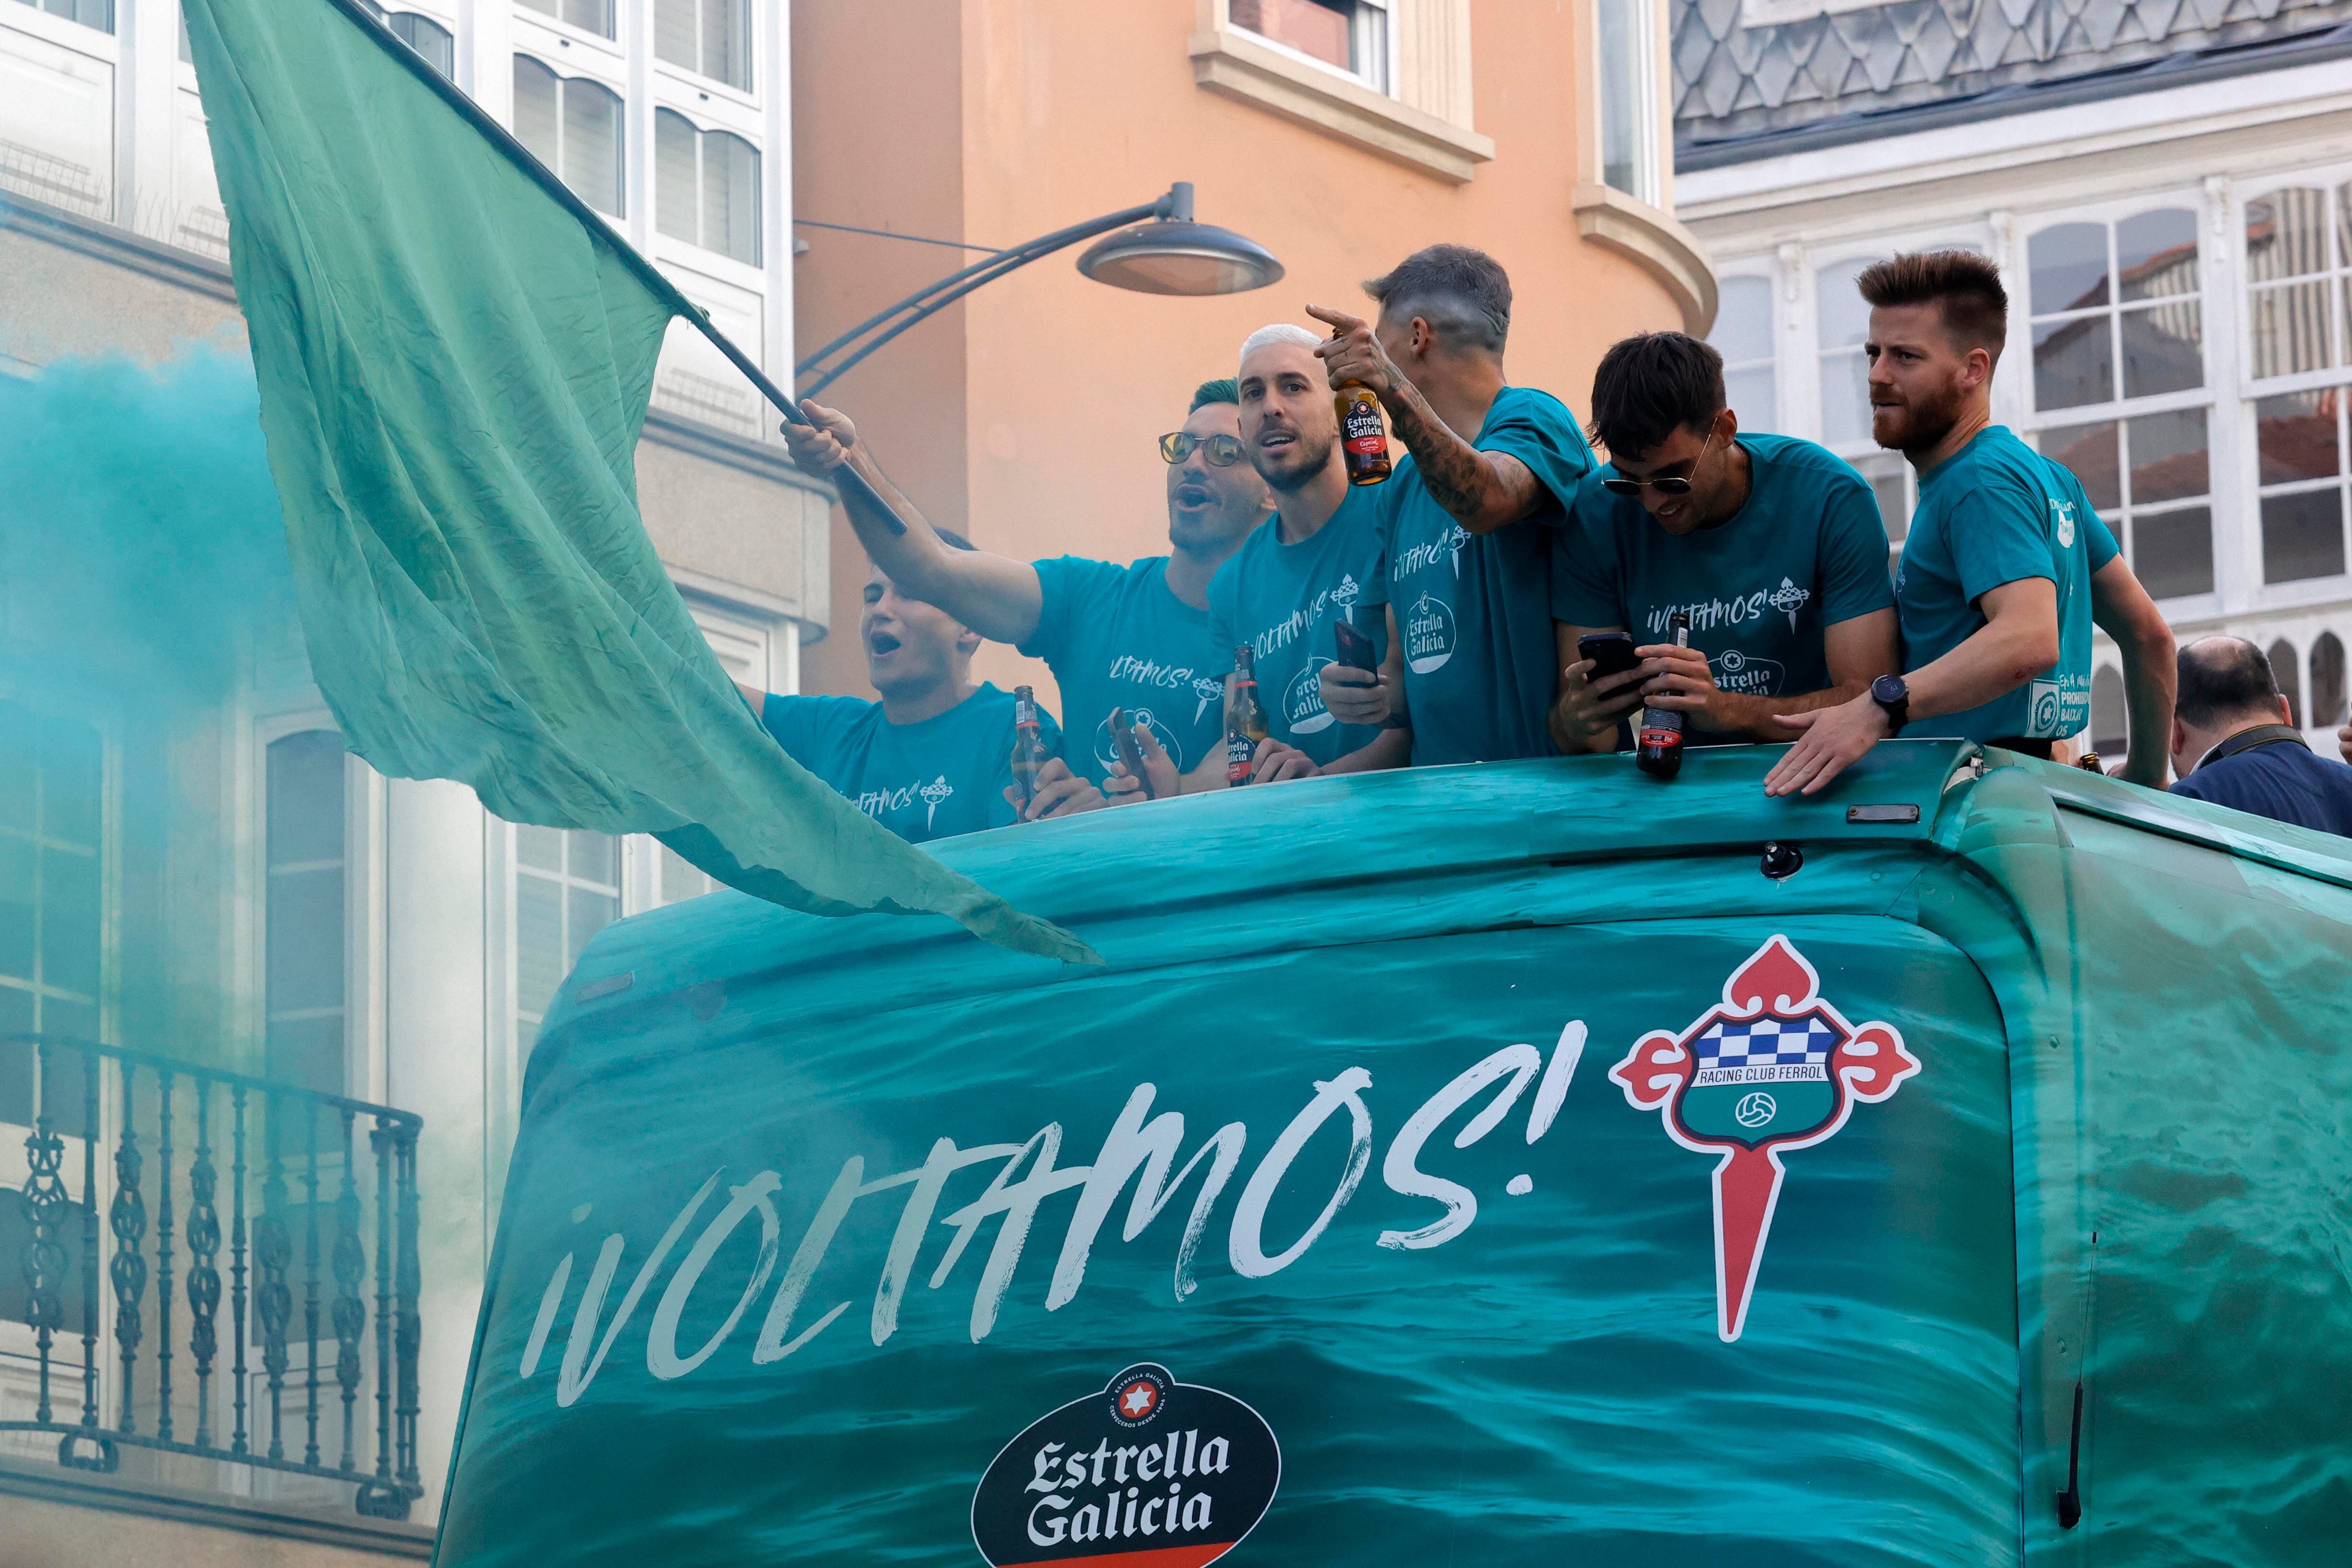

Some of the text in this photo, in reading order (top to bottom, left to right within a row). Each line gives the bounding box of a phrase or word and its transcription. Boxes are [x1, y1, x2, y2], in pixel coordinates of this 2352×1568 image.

[1347, 415, 1382, 429] Estrella
[1349, 425, 1382, 439] Galicia
[1409, 614, 1443, 637] Estrella
[1411, 632, 1445, 656] Galicia
[1712, 670, 1770, 688] strella
[1228, 742, 1248, 753] trella
[1228, 752, 1247, 763] licia
[1700, 1066, 1822, 1084] RACING CLUB FERROL
[520, 1019, 1587, 1408] ¡VOLTAMOS!
[1114, 1372, 1165, 1394] ESTRELLA GALICIA
[1109, 1399, 1165, 1428] CERVECEROS DESDE 1906
[1024, 1428, 1230, 1494] Estrella
[1027, 1482, 1212, 1547] Galicia
